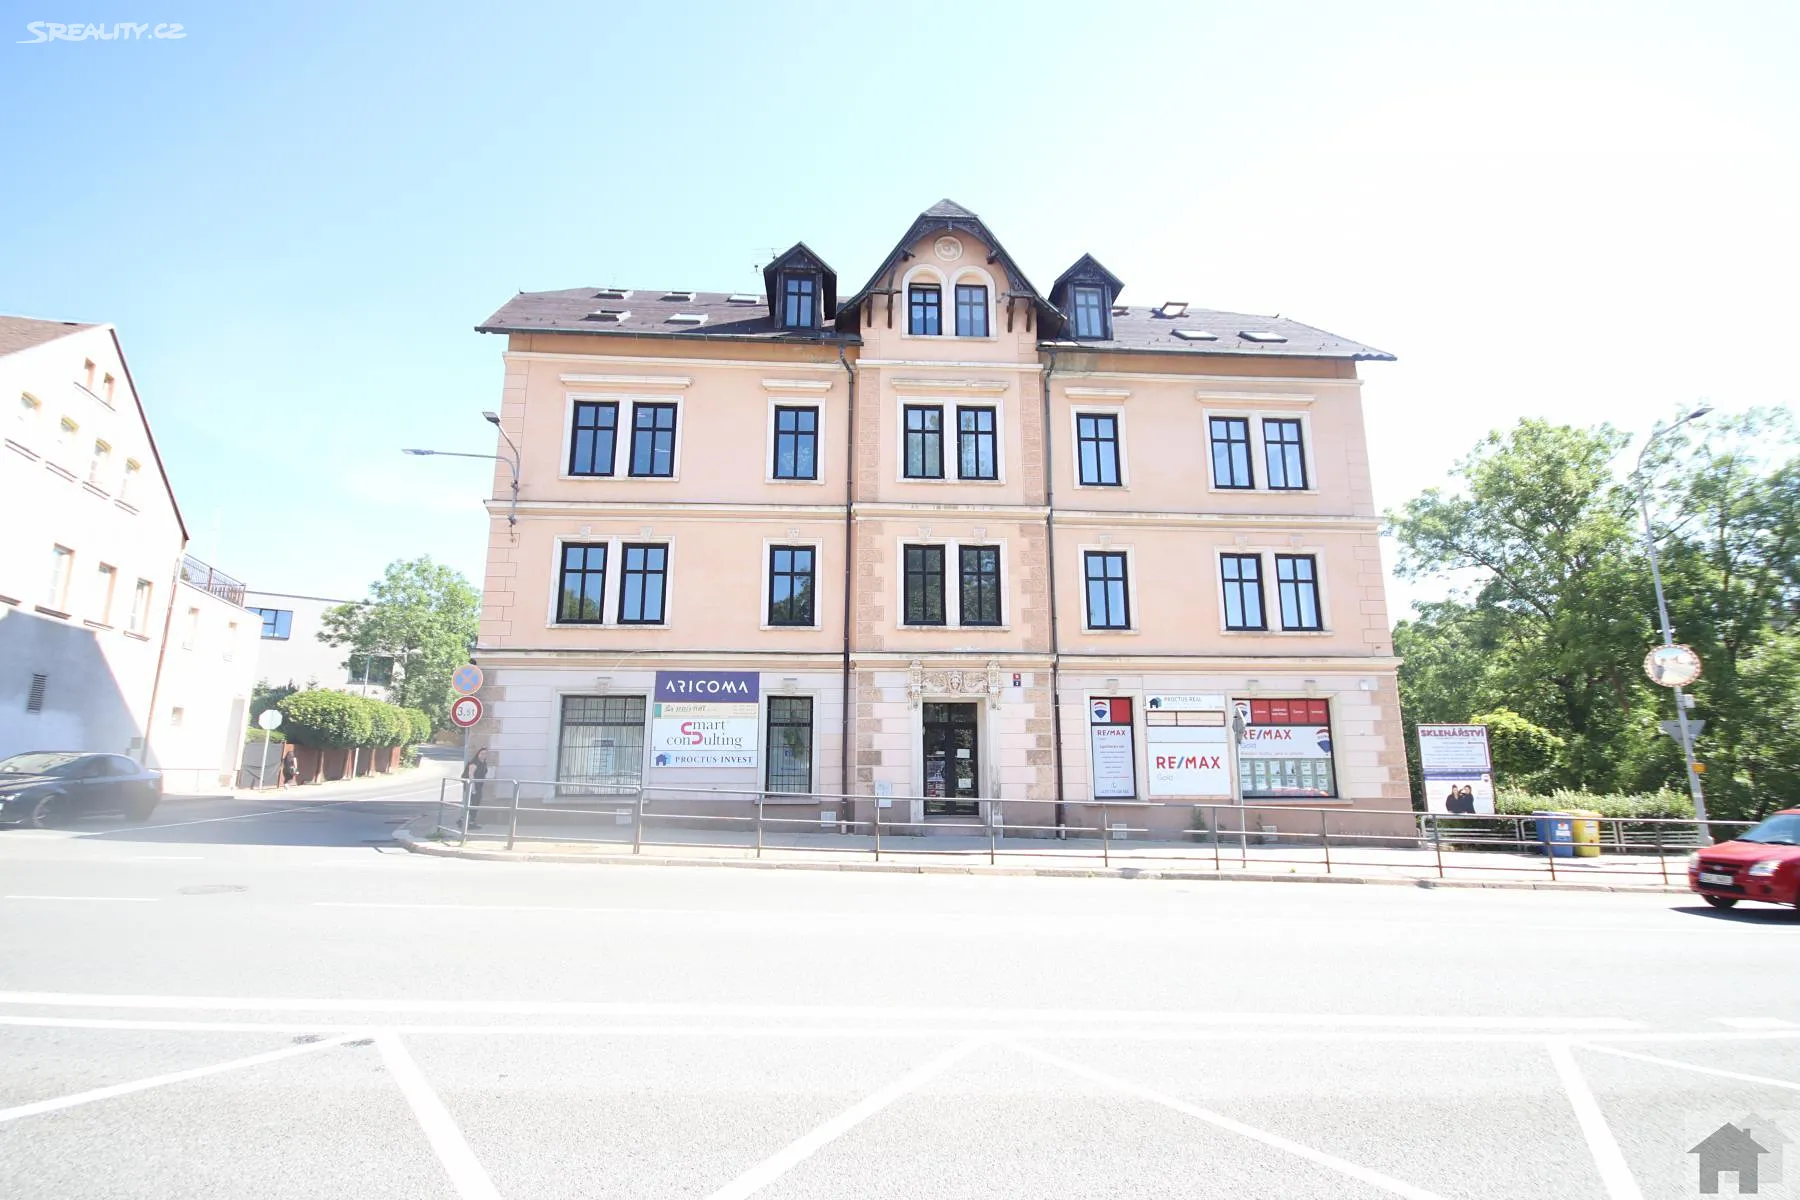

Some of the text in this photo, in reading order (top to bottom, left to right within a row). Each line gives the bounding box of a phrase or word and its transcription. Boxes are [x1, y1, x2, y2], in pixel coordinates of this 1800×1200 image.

[666, 680, 749, 693] ARICOMA
[675, 756, 752, 764] PROCTUS INVEST
[1156, 756, 1221, 769] RE/MAX
